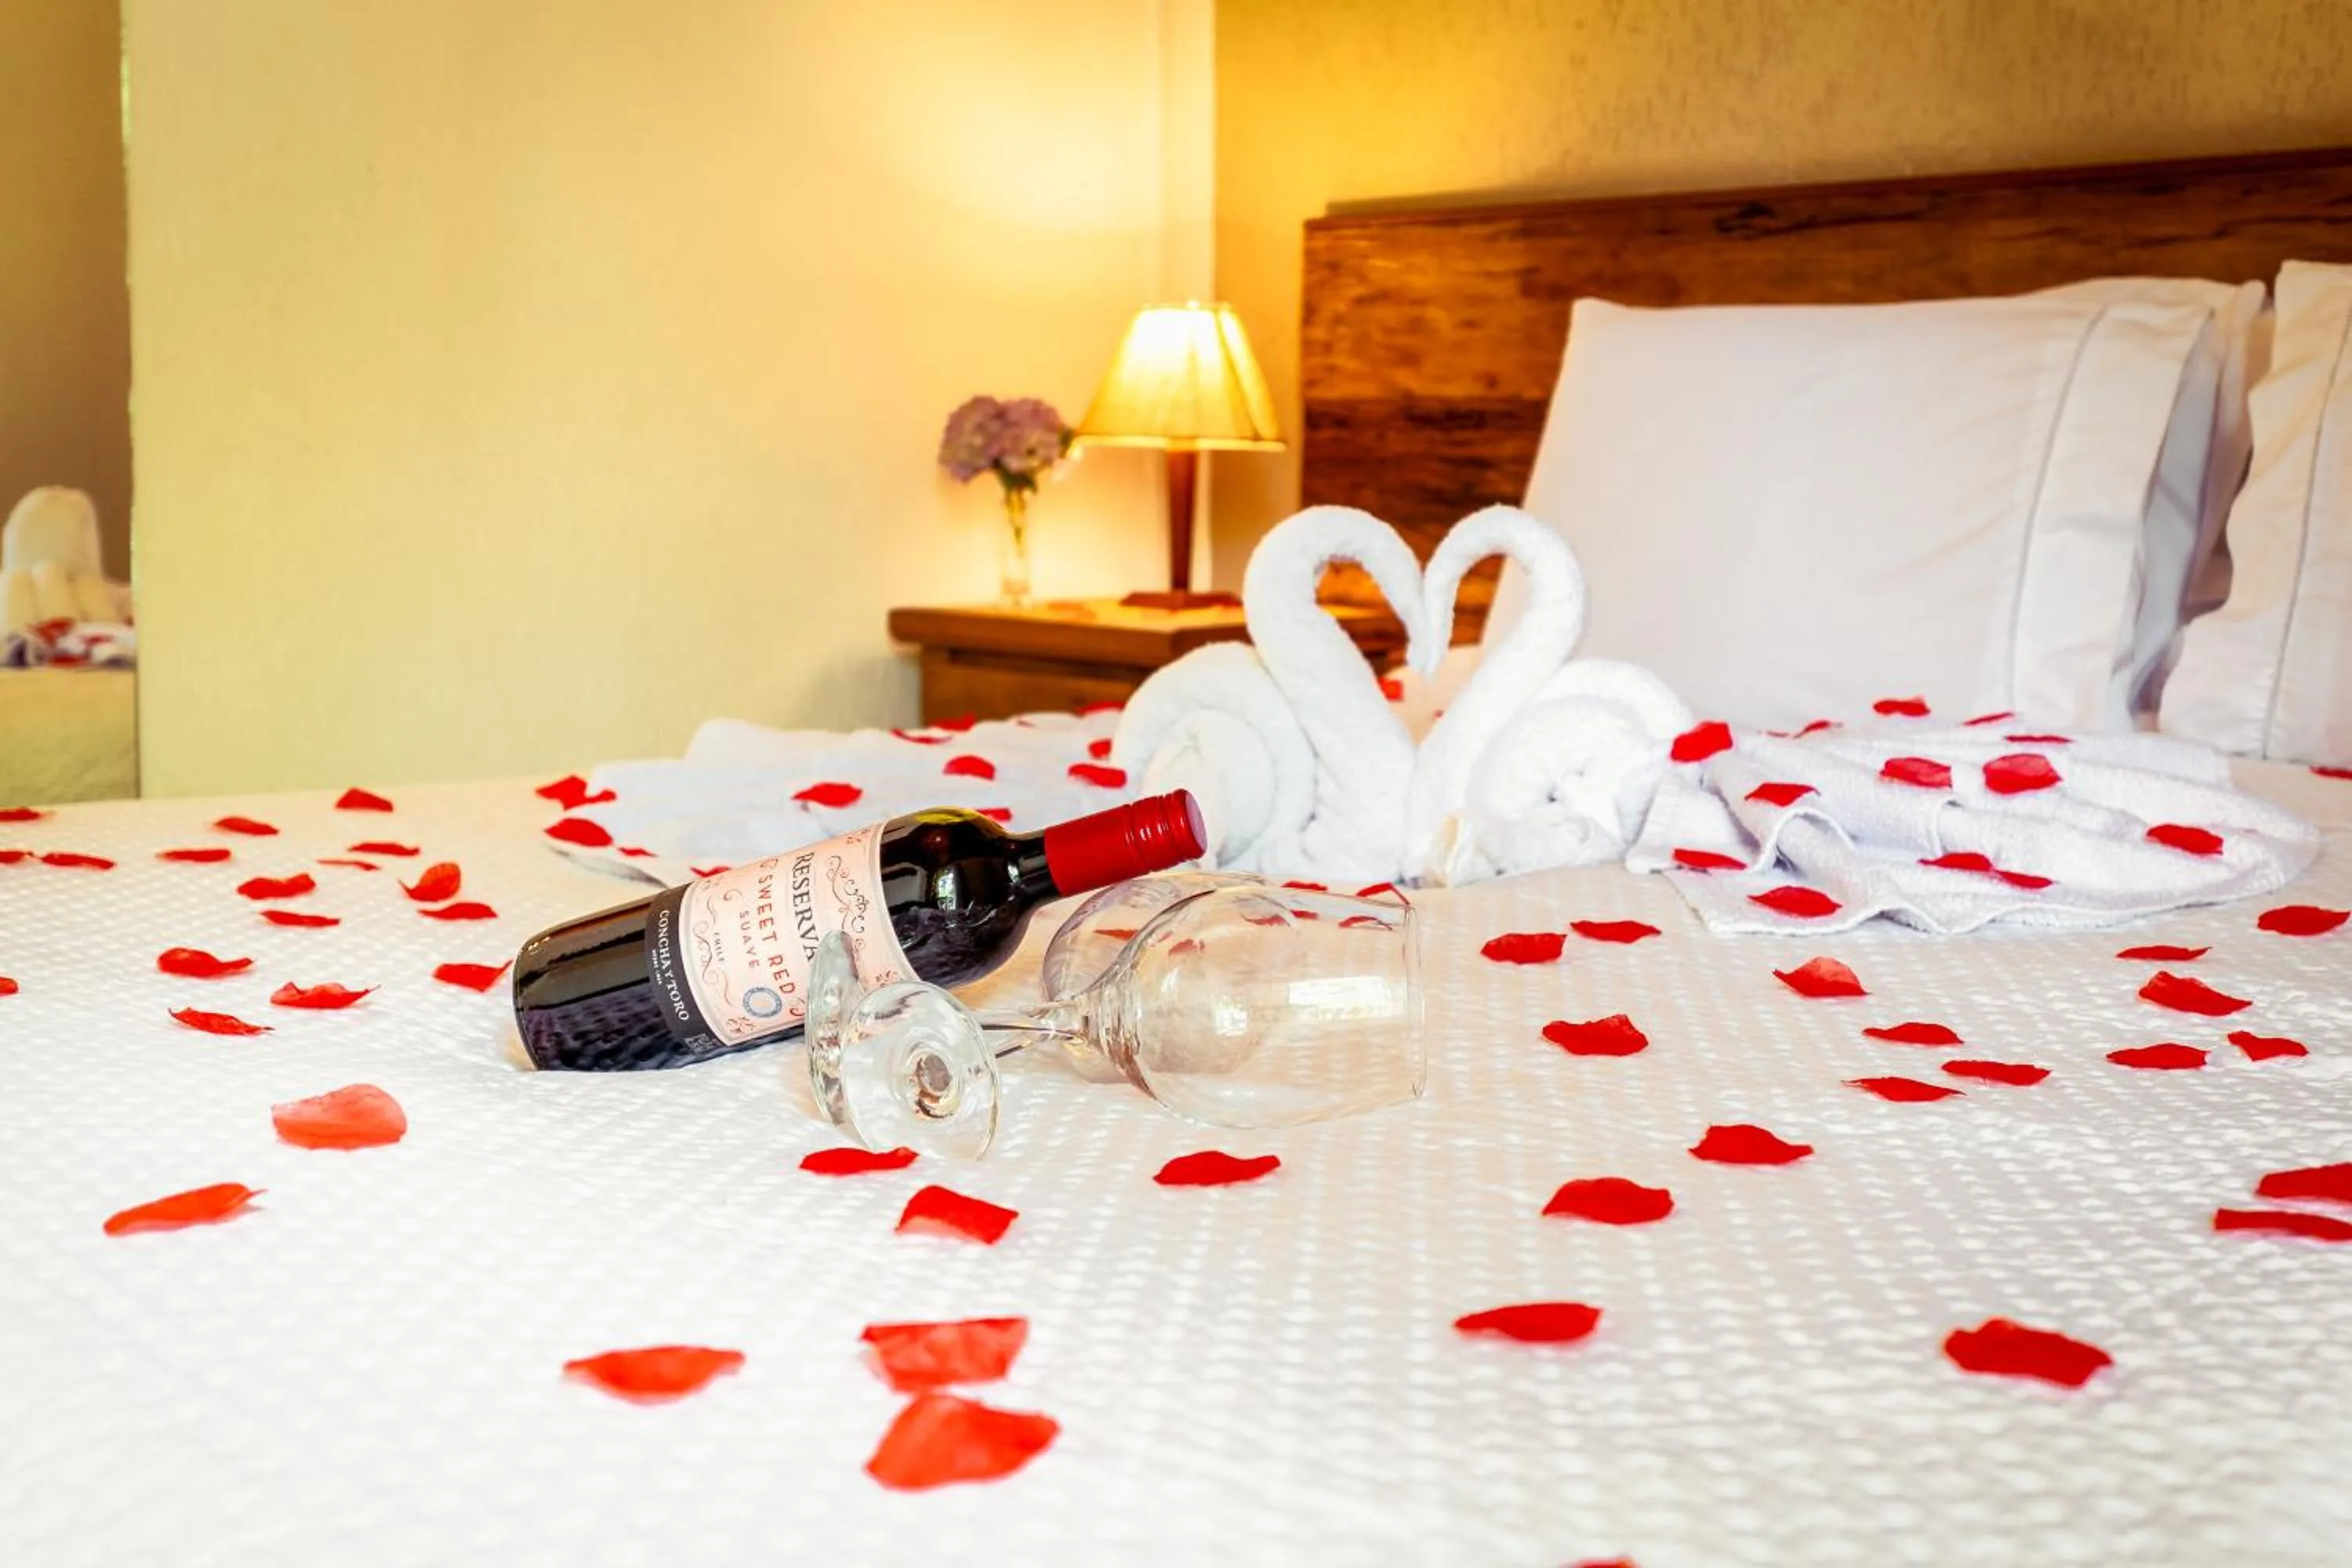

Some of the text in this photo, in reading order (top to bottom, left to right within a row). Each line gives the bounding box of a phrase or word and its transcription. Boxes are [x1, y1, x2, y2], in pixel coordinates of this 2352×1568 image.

[739, 910, 760, 968] SUAVE
[757, 874, 796, 994] SWEET RED
[792, 851, 819, 963] RESERVA
[658, 909, 690, 1021] CONCHA Y TORO
